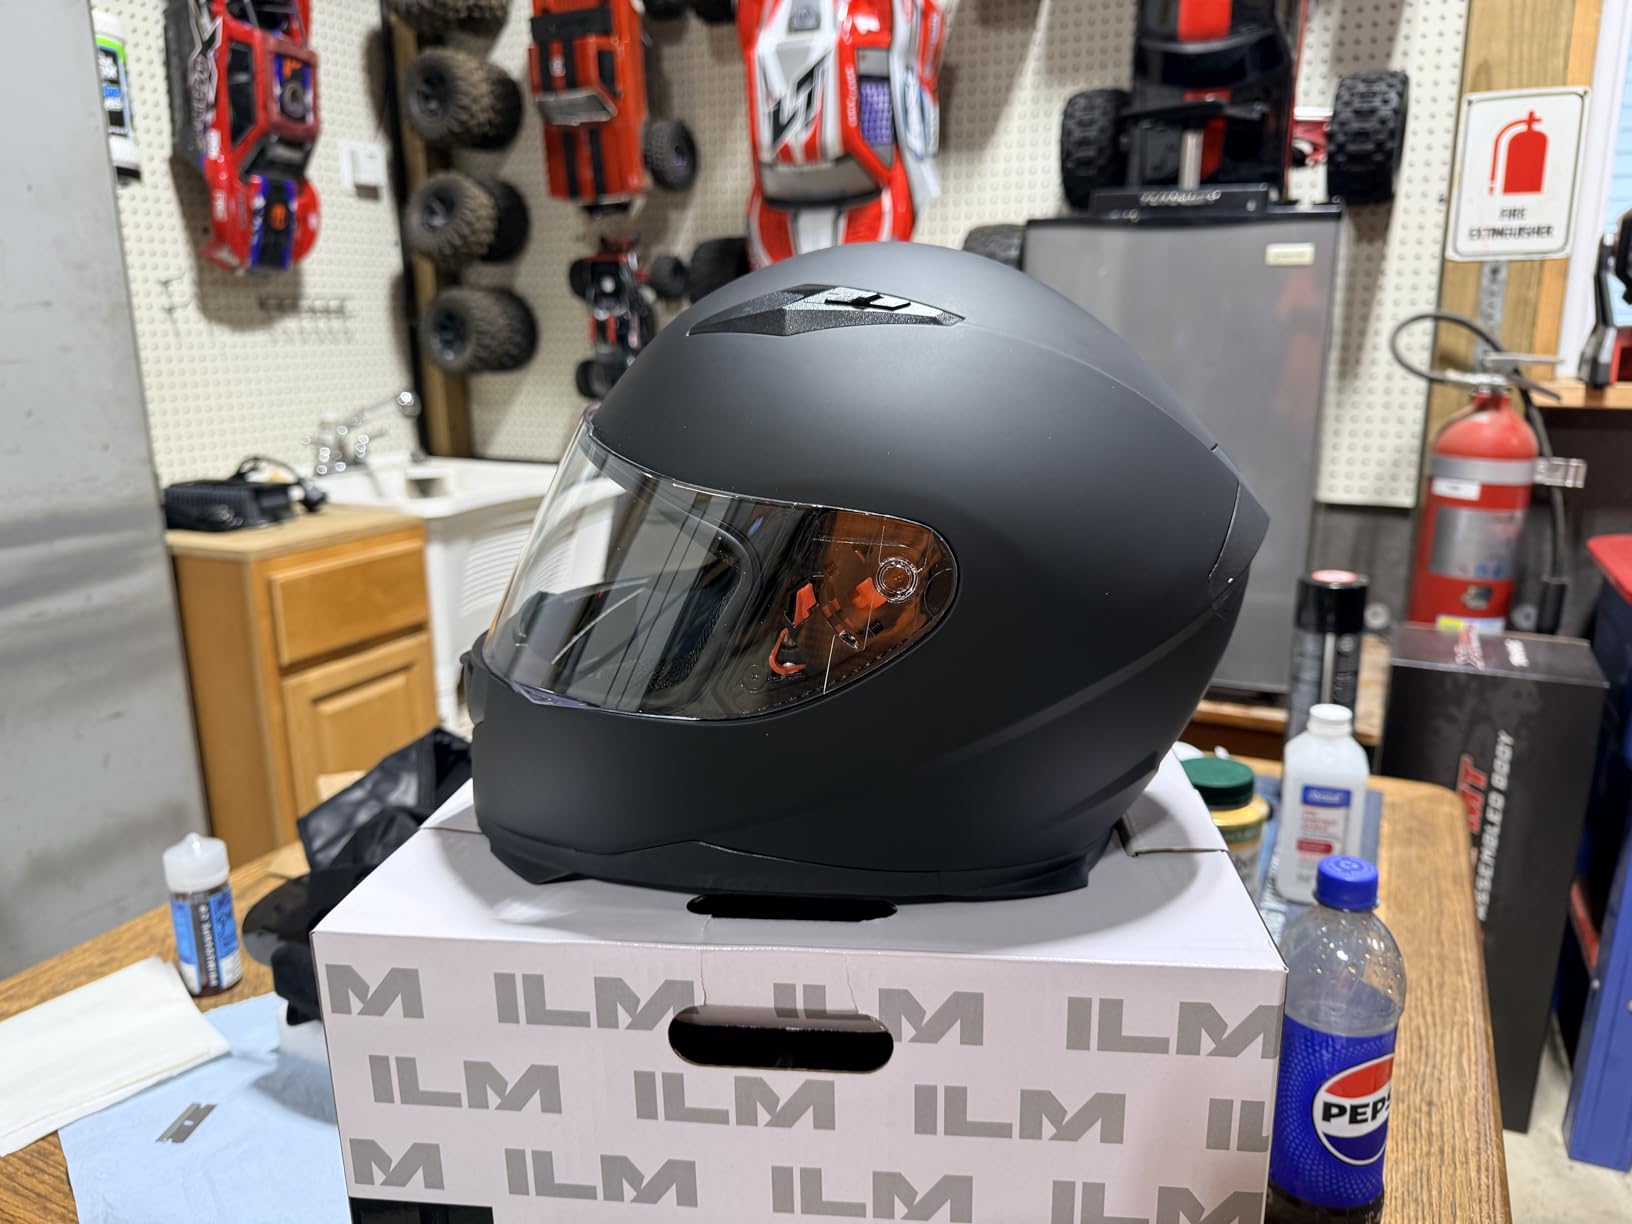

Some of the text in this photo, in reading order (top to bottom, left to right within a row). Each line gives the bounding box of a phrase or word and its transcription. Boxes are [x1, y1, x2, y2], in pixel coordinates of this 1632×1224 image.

[1468, 225, 1554, 240] EXTINGUISHER
[1499, 207, 1527, 221] FIRE
[1490, 729, 1515, 791] BODY
[494, 973, 695, 1031] ILM
[1066, 997, 1284, 1059] ILM
[369, 1055, 562, 1114] ILM
[634, 1070, 835, 1130] ILM
[914, 1084, 1126, 1144] ILM
[505, 1148, 698, 1208] ILM
[771, 1166, 973, 1223] ILM
[1051, 1180, 1264, 1224] ILM
